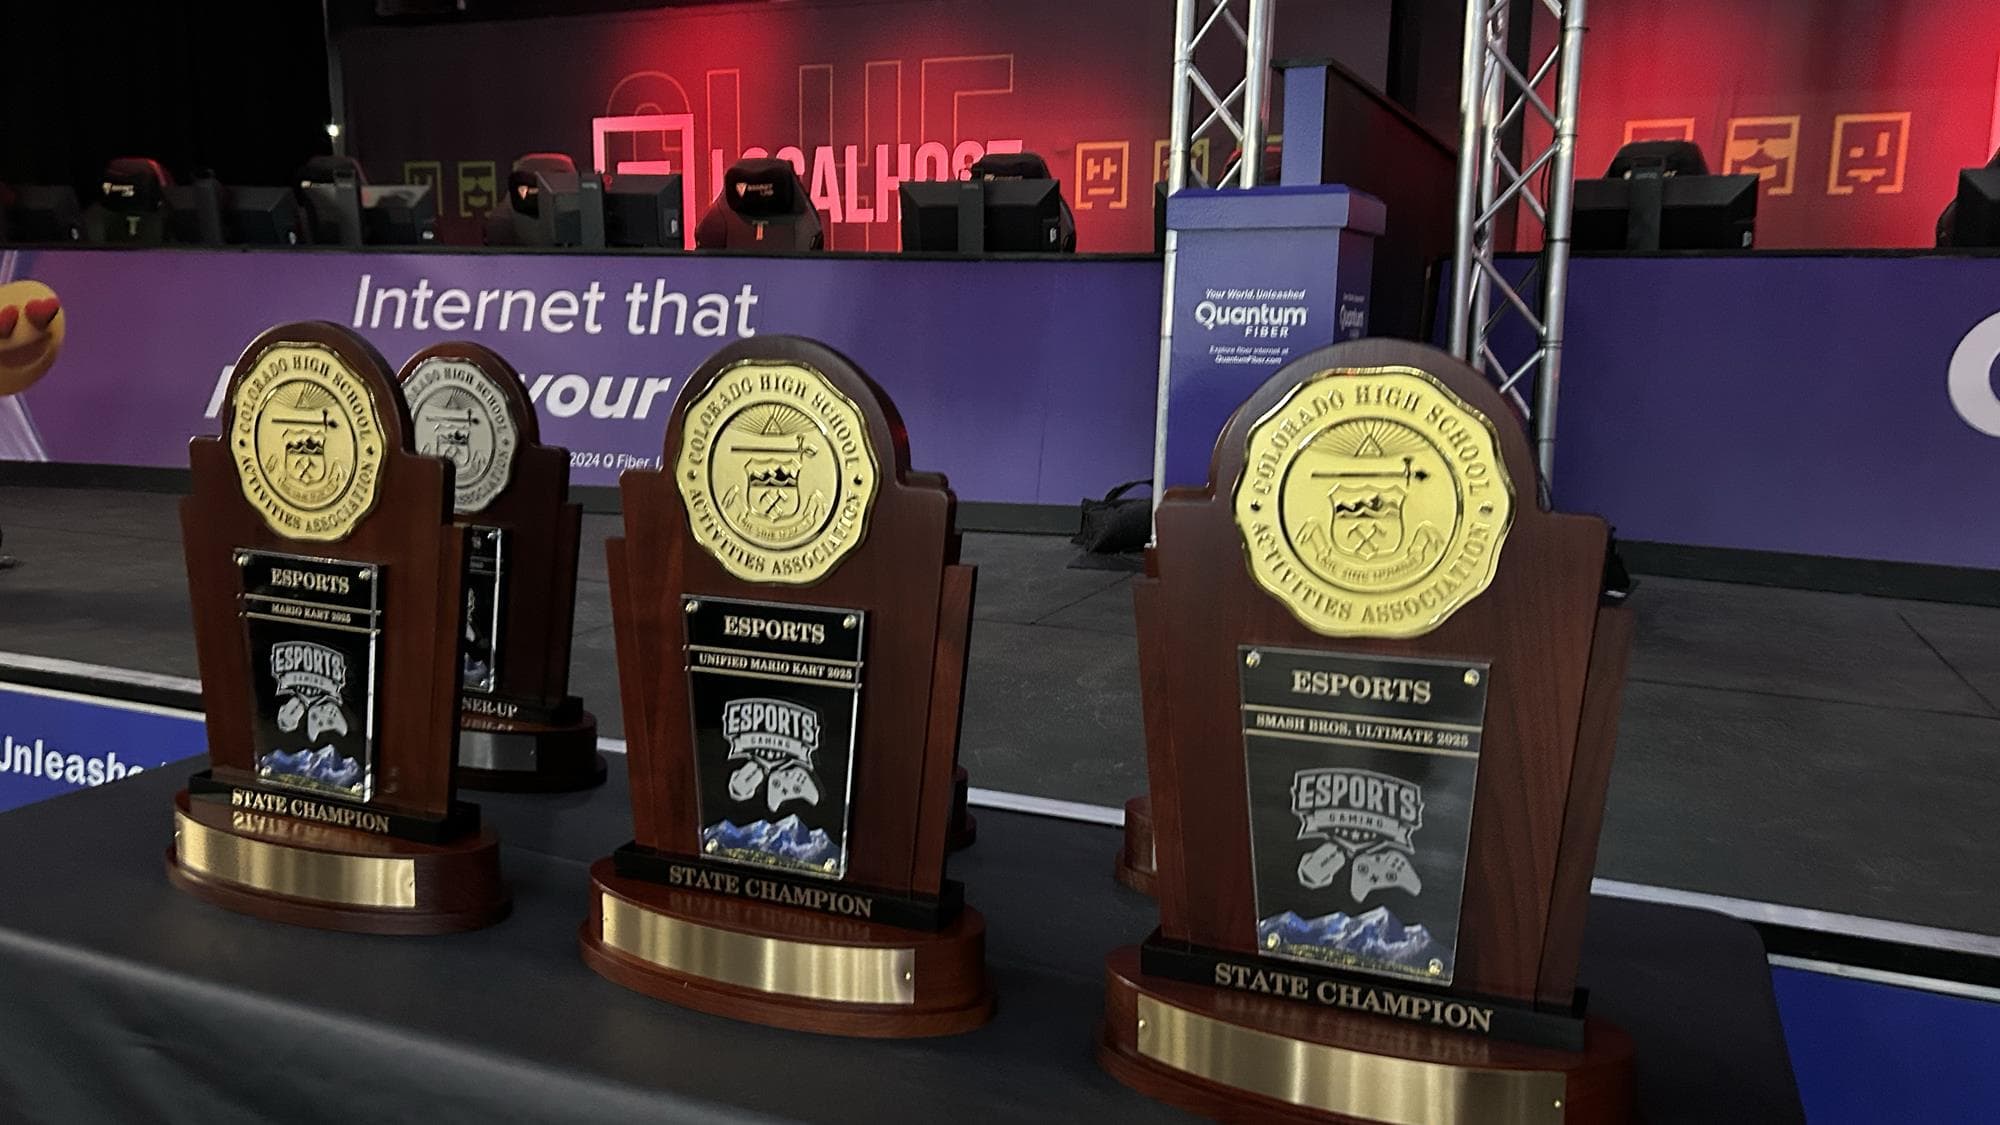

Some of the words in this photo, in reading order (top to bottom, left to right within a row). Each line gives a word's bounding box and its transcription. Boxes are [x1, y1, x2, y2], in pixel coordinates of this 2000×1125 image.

[353, 274, 605, 333] Internet
[627, 278, 758, 338] that
[1206, 288, 1225, 298] Your
[1256, 289, 1306, 299] Unleashed
[1195, 301, 1308, 330] Quantum
[1245, 326, 1289, 338] FIBER
[240, 357, 288, 434] COLORADO
[293, 355, 330, 378] HIGH
[332, 371, 371, 440] SCHOOL
[444, 367, 474, 385] HIGH
[475, 381, 508, 434] SCHOOL
[689, 376, 753, 466] COLORADO
[759, 373, 809, 398] HIGH
[812, 391, 859, 470] SCHOOL
[570, 451, 600, 468] 2024
[1252, 389, 1345, 494] COLORADO
[1355, 384, 1421, 412] HIGH
[1424, 403, 1490, 498] SCHOOL
[242, 455, 301, 530] ACTIVITIES
[306, 462, 373, 533] ASSOCIATION
[689, 489, 765, 573] ACTIVITIES
[772, 491, 861, 576] ASSOCIATION
[270, 567, 350, 595] ESPORTS
[1252, 521, 1353, 622] ACTIVITIES
[1360, 522, 1490, 624] ASSOCIATION
[271, 603, 302, 617] MARIO
[303, 606, 330, 621] KART
[331, 610, 351, 624] 2025
[723, 615, 825, 644] ESPORTS
[275, 645, 343, 682] ESPORTS
[699, 653, 748, 669] UNIFIED
[750, 658, 789, 673] MARIO
[792, 663, 825, 678] KART
[827, 668, 853, 681] 2025
[1291, 670, 1431, 704] ESPORTS
[727, 703, 815, 743] ESPORTS
[751, 735, 791, 749] GAMING
[1256, 714, 1305, 732] SMASH
[1356, 723, 1433, 745] ULTIMATE
[1436, 732, 1469, 748] 2025
[232, 787, 287, 814] STATE
[290, 799, 390, 833] CHAMPION
[1298, 774, 1416, 822] ESPORTS
[1328, 813, 1384, 829] GAMING
[669, 865, 739, 894] STATE
[745, 879, 873, 918] CHAMPION
[1215, 963, 1308, 1000] STATE
[1317, 981, 1493, 1033] CHAMPION
